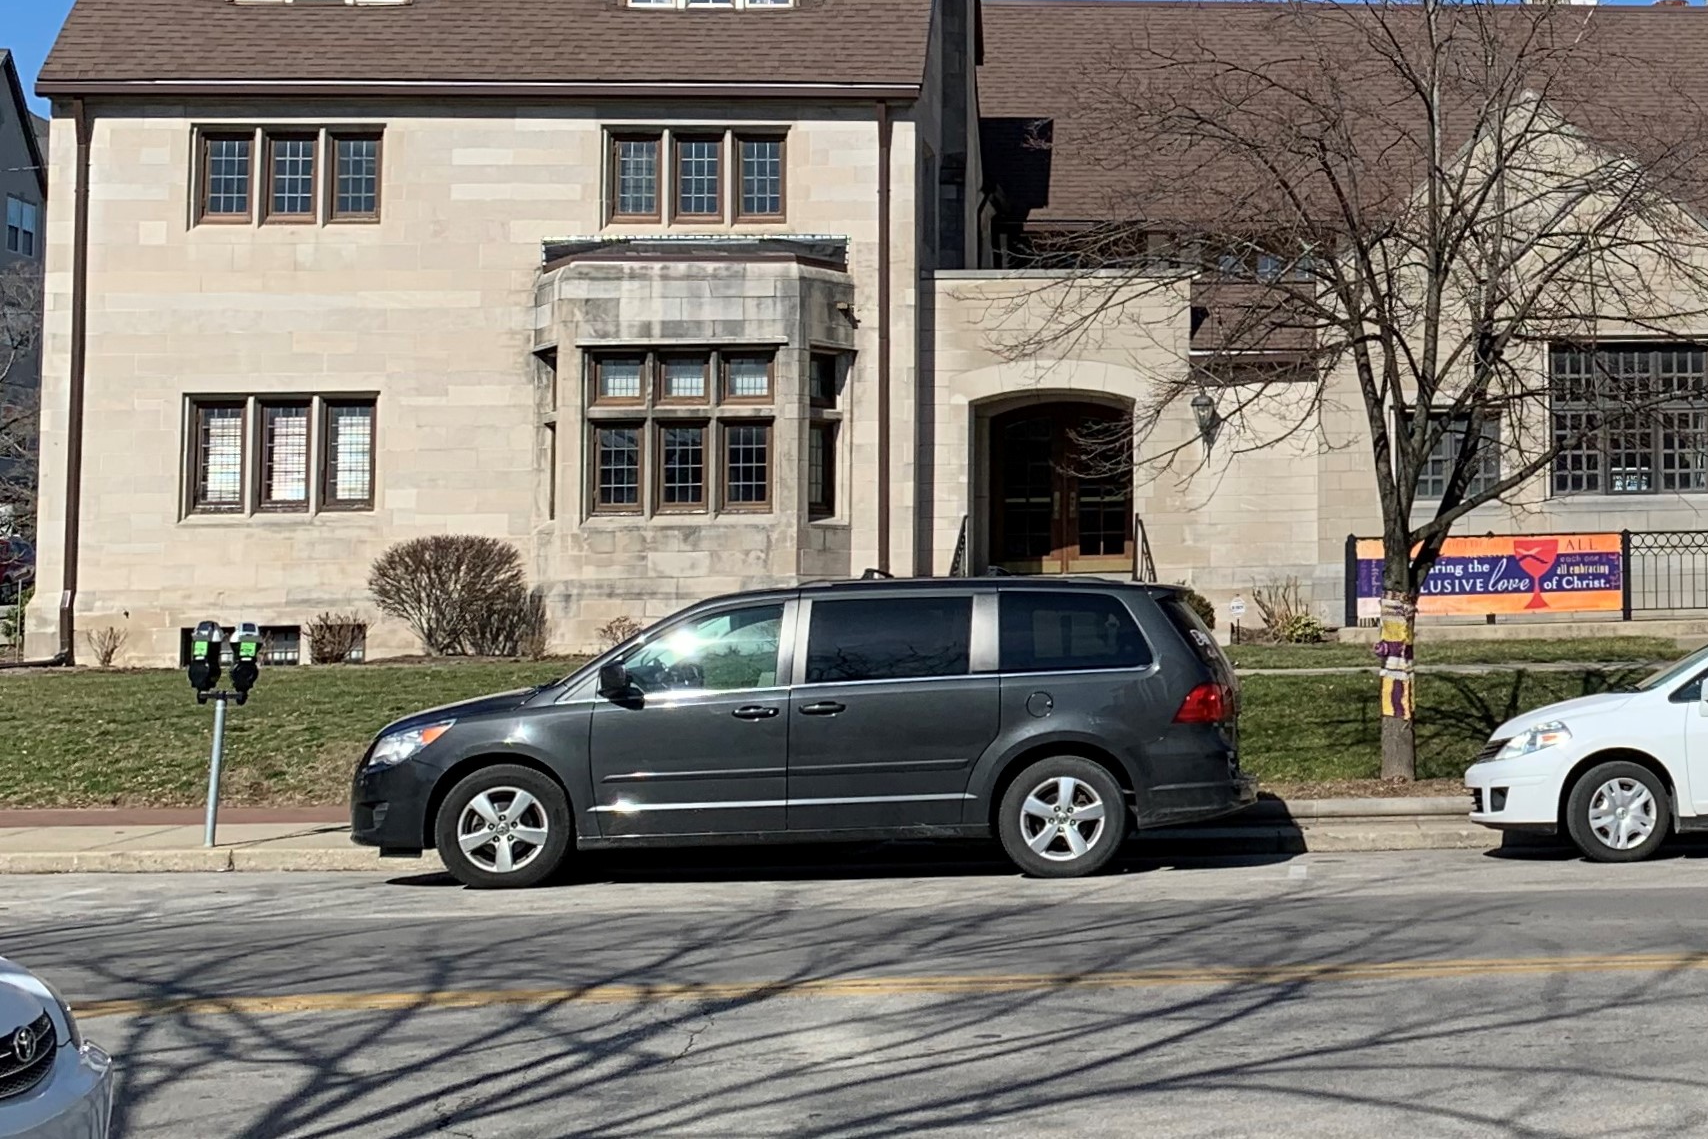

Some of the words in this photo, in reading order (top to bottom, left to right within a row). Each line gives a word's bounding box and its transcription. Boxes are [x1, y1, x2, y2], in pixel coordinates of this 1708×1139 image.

[1565, 538, 1598, 551] ALL
[1468, 560, 1490, 573] the
[1557, 563, 1569, 575] all
[1570, 563, 1610, 575] embracing
[1420, 578, 1486, 594] LUSIVE
[1488, 558, 1530, 592] love
[1543, 576, 1558, 590] of
[1562, 575, 1610, 590] Christ.
